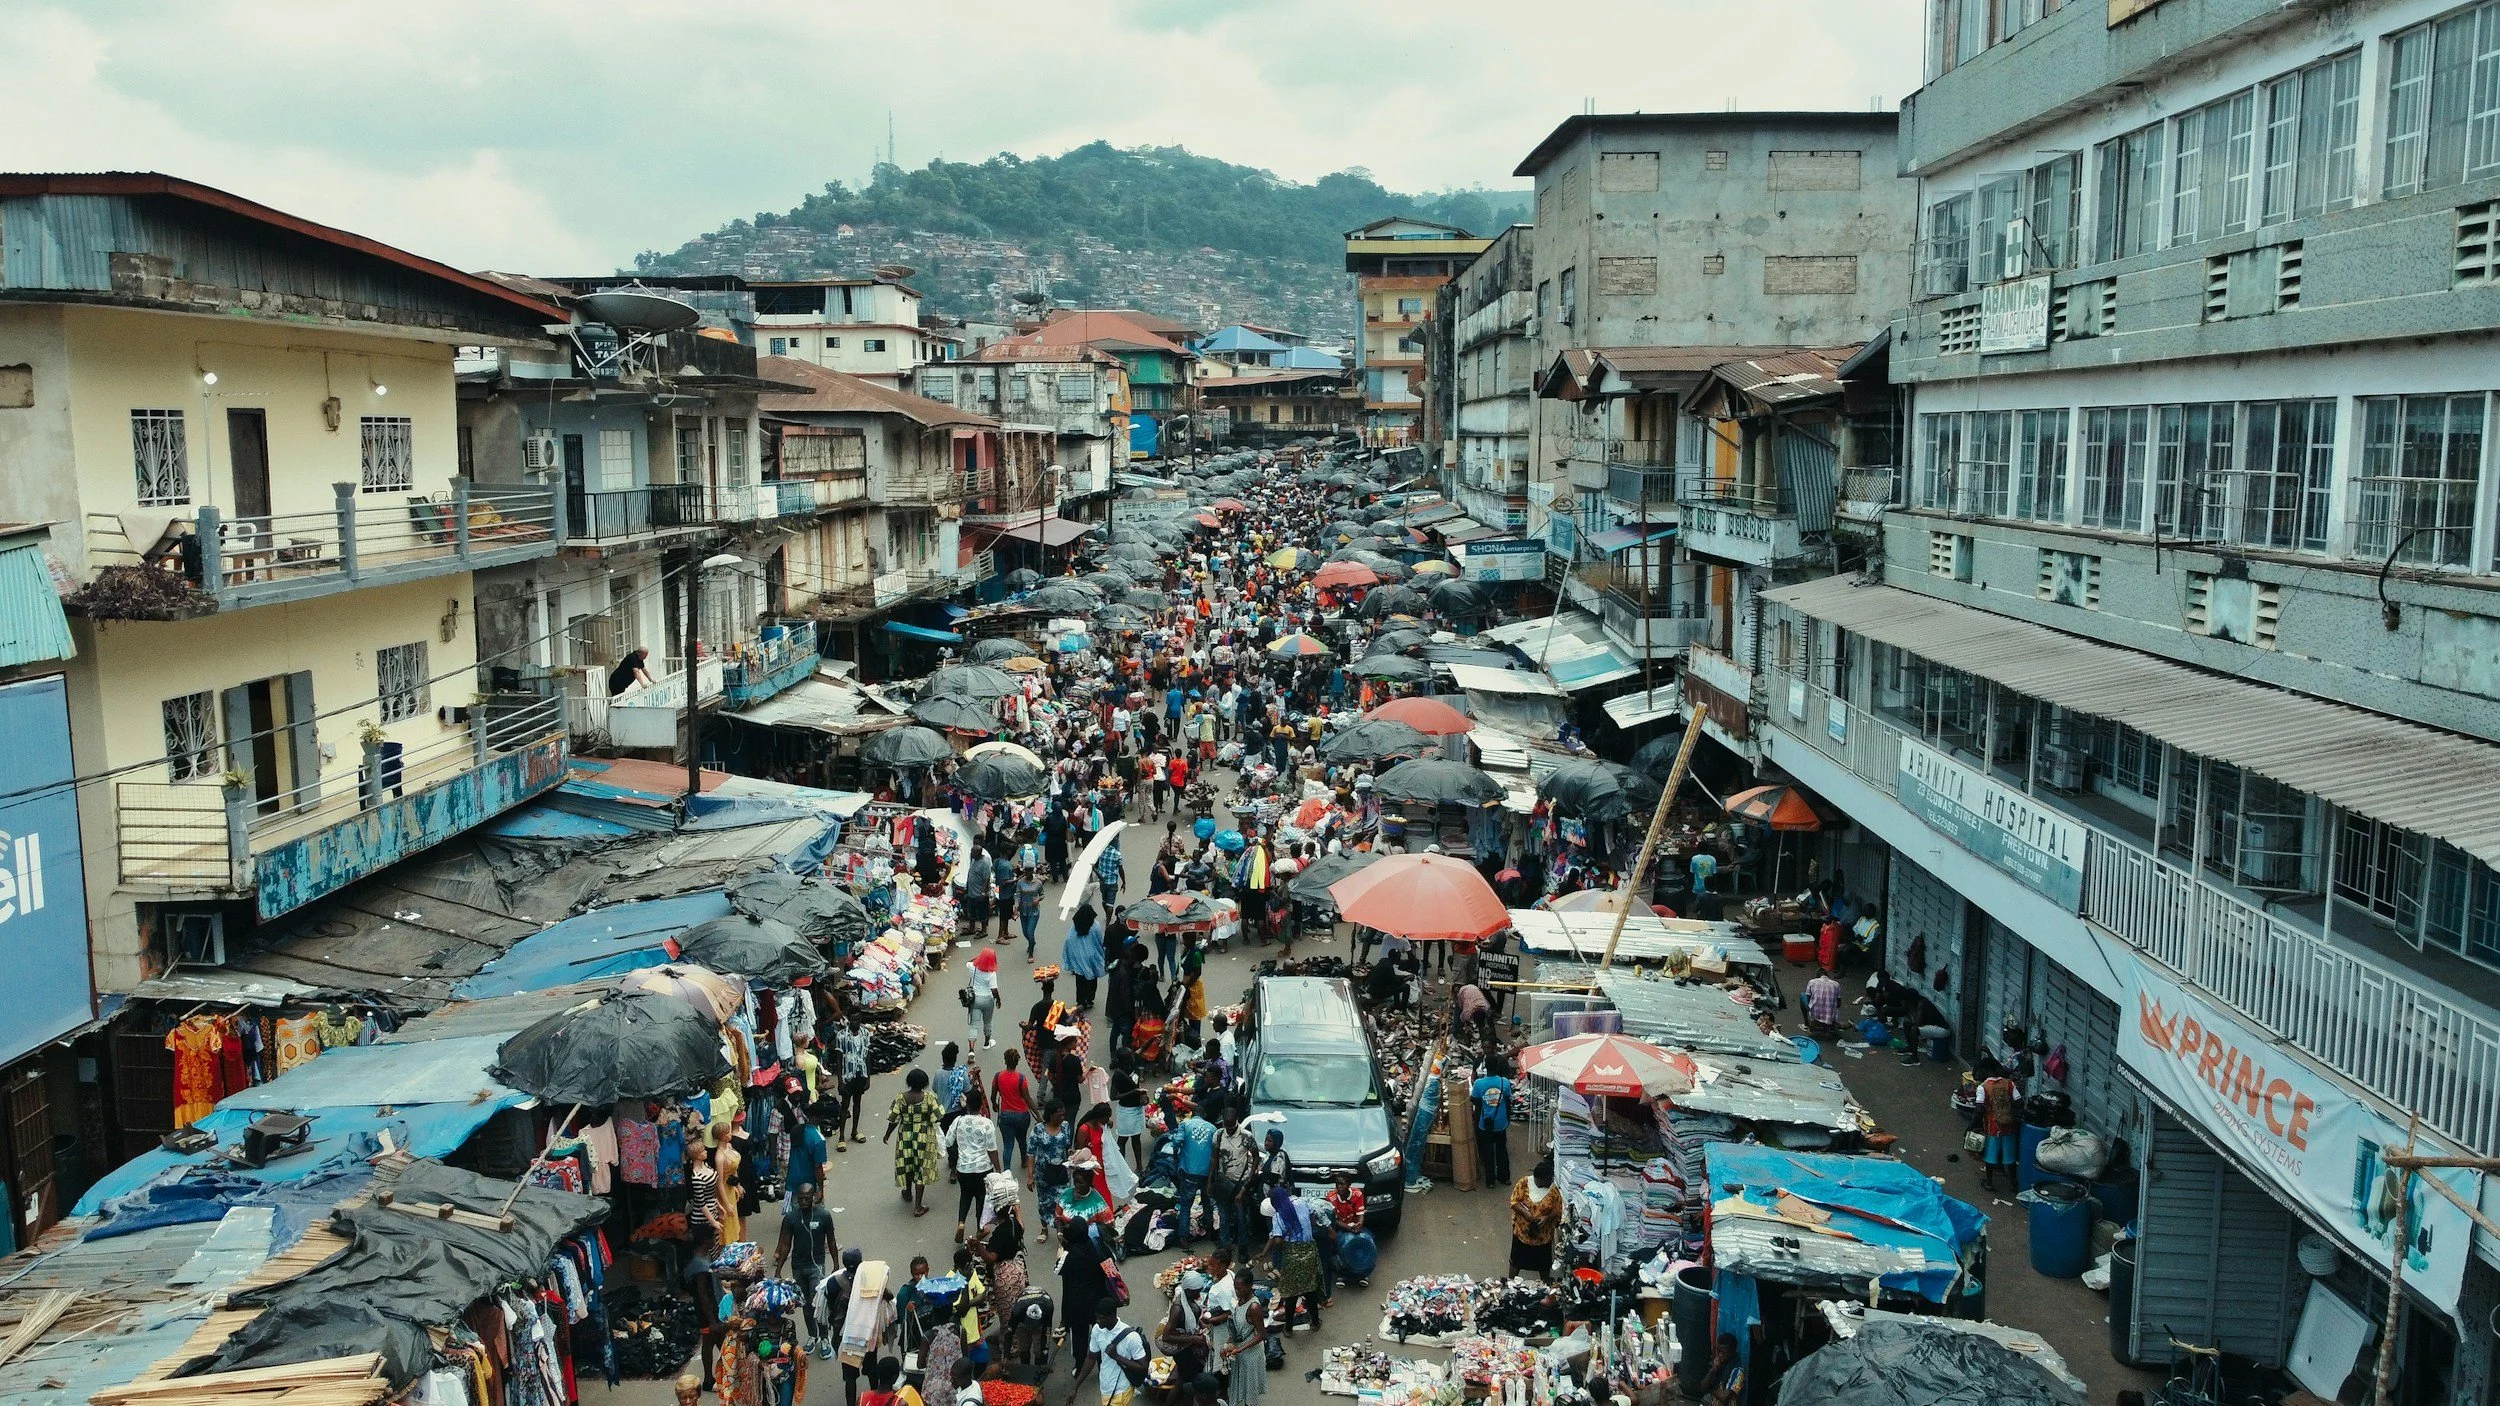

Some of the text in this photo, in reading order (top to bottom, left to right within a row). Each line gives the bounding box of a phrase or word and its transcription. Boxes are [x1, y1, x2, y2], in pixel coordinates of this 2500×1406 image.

[1984, 282, 2031, 315] ABANITA
[1471, 544, 1538, 553] SHONA enterprise
[1908, 748, 2070, 862] ABANITA HOSPITAL
[1926, 788, 1953, 814] ECOWAS
[1480, 951, 1519, 966] ABANITA
[1485, 962, 1510, 971] HOSPITAL
[1477, 977, 1491, 990] NO
[1478, 967, 1514, 981] NO PARKING
[2176, 1016, 2315, 1152] PRINCE
[2142, 1084, 2174, 1115] INVESTMENT
[2213, 1101, 2250, 1139] PIPING
[2250, 1129, 2303, 1177] SYSTEMS
